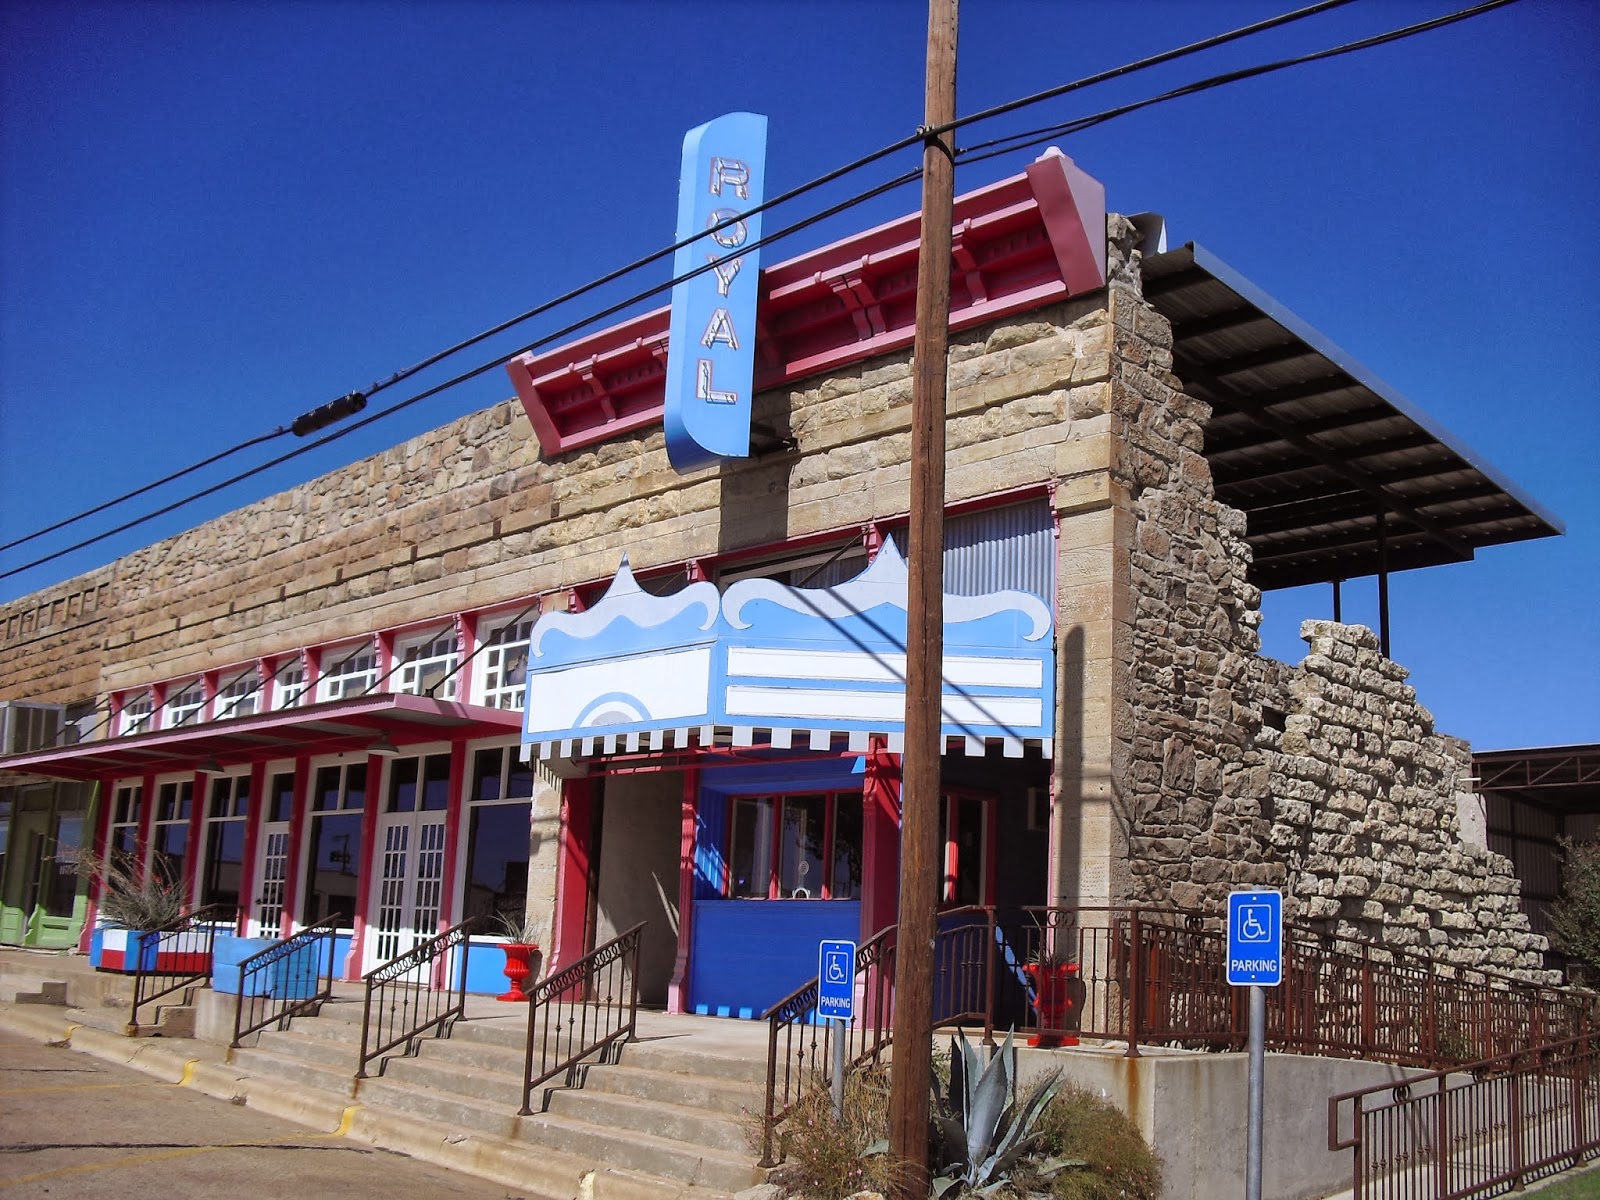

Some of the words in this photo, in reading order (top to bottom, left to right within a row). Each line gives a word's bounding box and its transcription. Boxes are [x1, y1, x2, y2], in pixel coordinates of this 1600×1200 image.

[696, 157, 750, 405] ROYAL
[1231, 959, 1277, 972] PARKING
[820, 996, 851, 1008] PARKING
